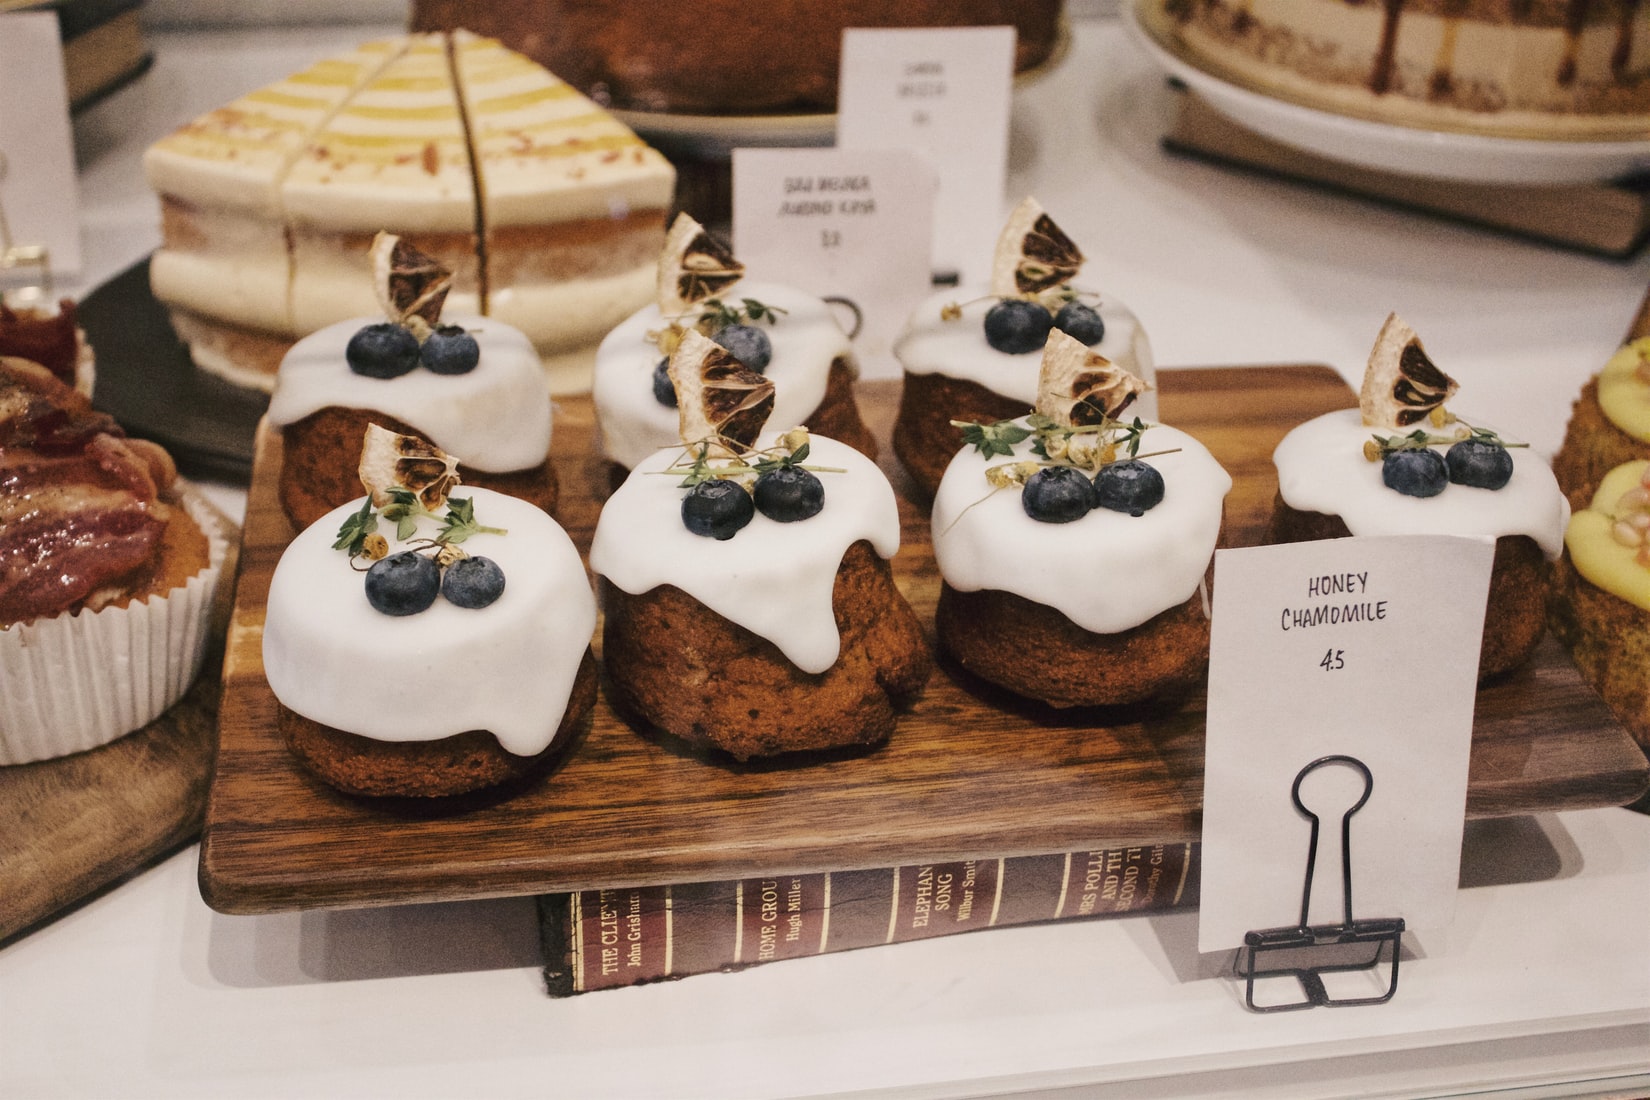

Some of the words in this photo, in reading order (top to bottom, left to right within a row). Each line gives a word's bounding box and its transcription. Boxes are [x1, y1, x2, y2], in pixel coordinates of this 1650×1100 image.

[1308, 571, 1368, 598] HONEY
[1281, 601, 1388, 631] CHAMOMILE
[1320, 648, 1345, 672] 4.5
[1106, 848, 1122, 873] TH
[788, 879, 801, 912] Miller
[912, 863, 933, 929] ELEPHAN
[935, 873, 953, 911] SONG
[1102, 875, 1119, 899] AND
[1116, 866, 1139, 912] SECOND
[957, 890, 974, 922] Wilbur
[785, 914, 803, 941] Hugh
[627, 943, 641, 967] John
[758, 925, 777, 961] HOME
[601, 948, 619, 976] THE
